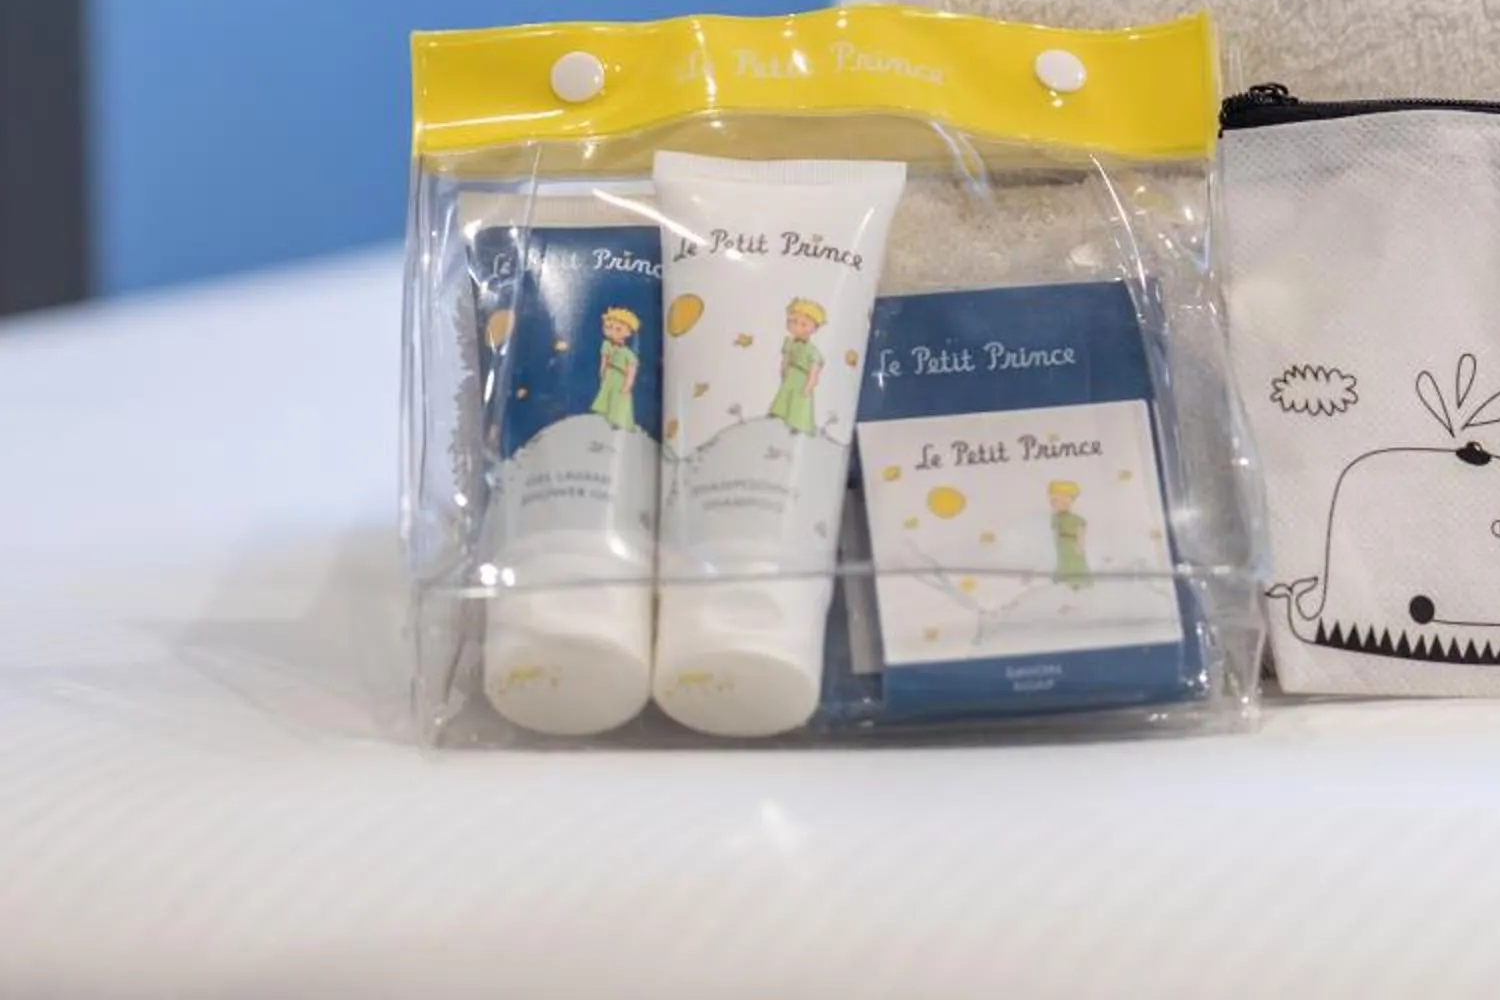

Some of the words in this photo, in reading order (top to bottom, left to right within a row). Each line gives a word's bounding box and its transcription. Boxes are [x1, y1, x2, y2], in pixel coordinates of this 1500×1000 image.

[830, 39, 946, 87] Prince
[592, 247, 662, 279] Princ
[673, 236, 699, 263] Le
[780, 230, 863, 270] Prince
[871, 348, 902, 378] Le
[911, 345, 976, 375] Petit
[983, 340, 1077, 371] Prince
[914, 442, 944, 471] Le
[950, 439, 1010, 467] Petit
[1016, 433, 1104, 462] Prince
